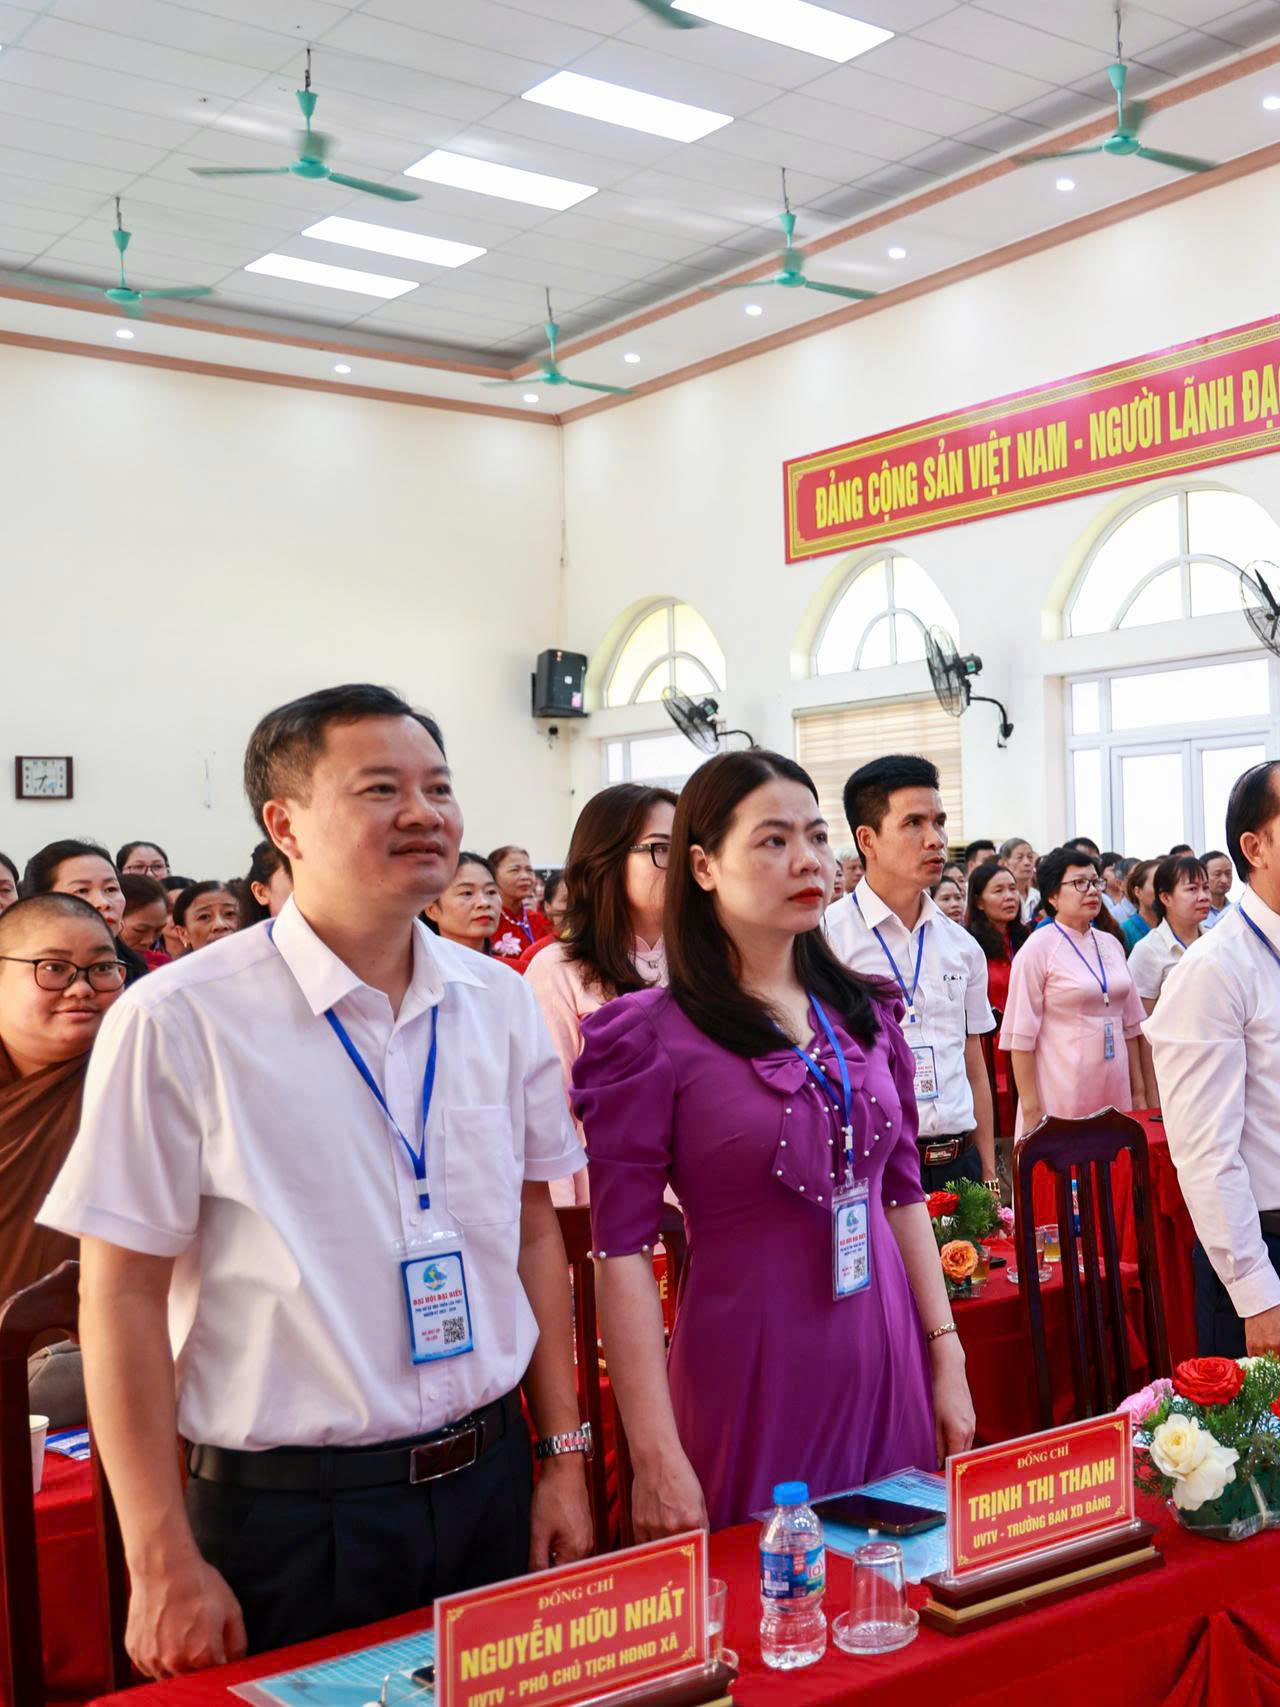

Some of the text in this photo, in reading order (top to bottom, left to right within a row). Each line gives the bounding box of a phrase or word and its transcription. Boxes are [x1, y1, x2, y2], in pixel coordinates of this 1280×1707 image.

[815, 467, 864, 529] ĐẢNG
[867, 458, 919, 522] CỘNG
[923, 439, 964, 502] SẢN
[968, 431, 1012, 496] VIỆT
[1016, 421, 1068, 479] NAM
[1073, 440, 1084, 449] -
[1089, 381, 1162, 461] NGƯỜI
[1168, 374, 1235, 441] LÃNH
[1016, 1442, 1069, 1468] ĐỒNG CHÍ
[967, 1480, 1022, 1521] TRỊNH
[1026, 1474, 1054, 1503] THỊ
[1059, 1457, 1116, 1494] THANH
[973, 1530, 998, 1547] UVTV
[1048, 1507, 1068, 1525] BAN
[537, 1576, 615, 1608] ĐỒNG CHÍ
[460, 1580, 685, 1680] NGUYỄN HỮU NHẤT
[518, 1669, 548, 1696] PHÓ
[552, 1662, 582, 1686] CHỦ
[584, 1653, 615, 1677] TỊCH
[659, 1631, 679, 1654] XÃ
